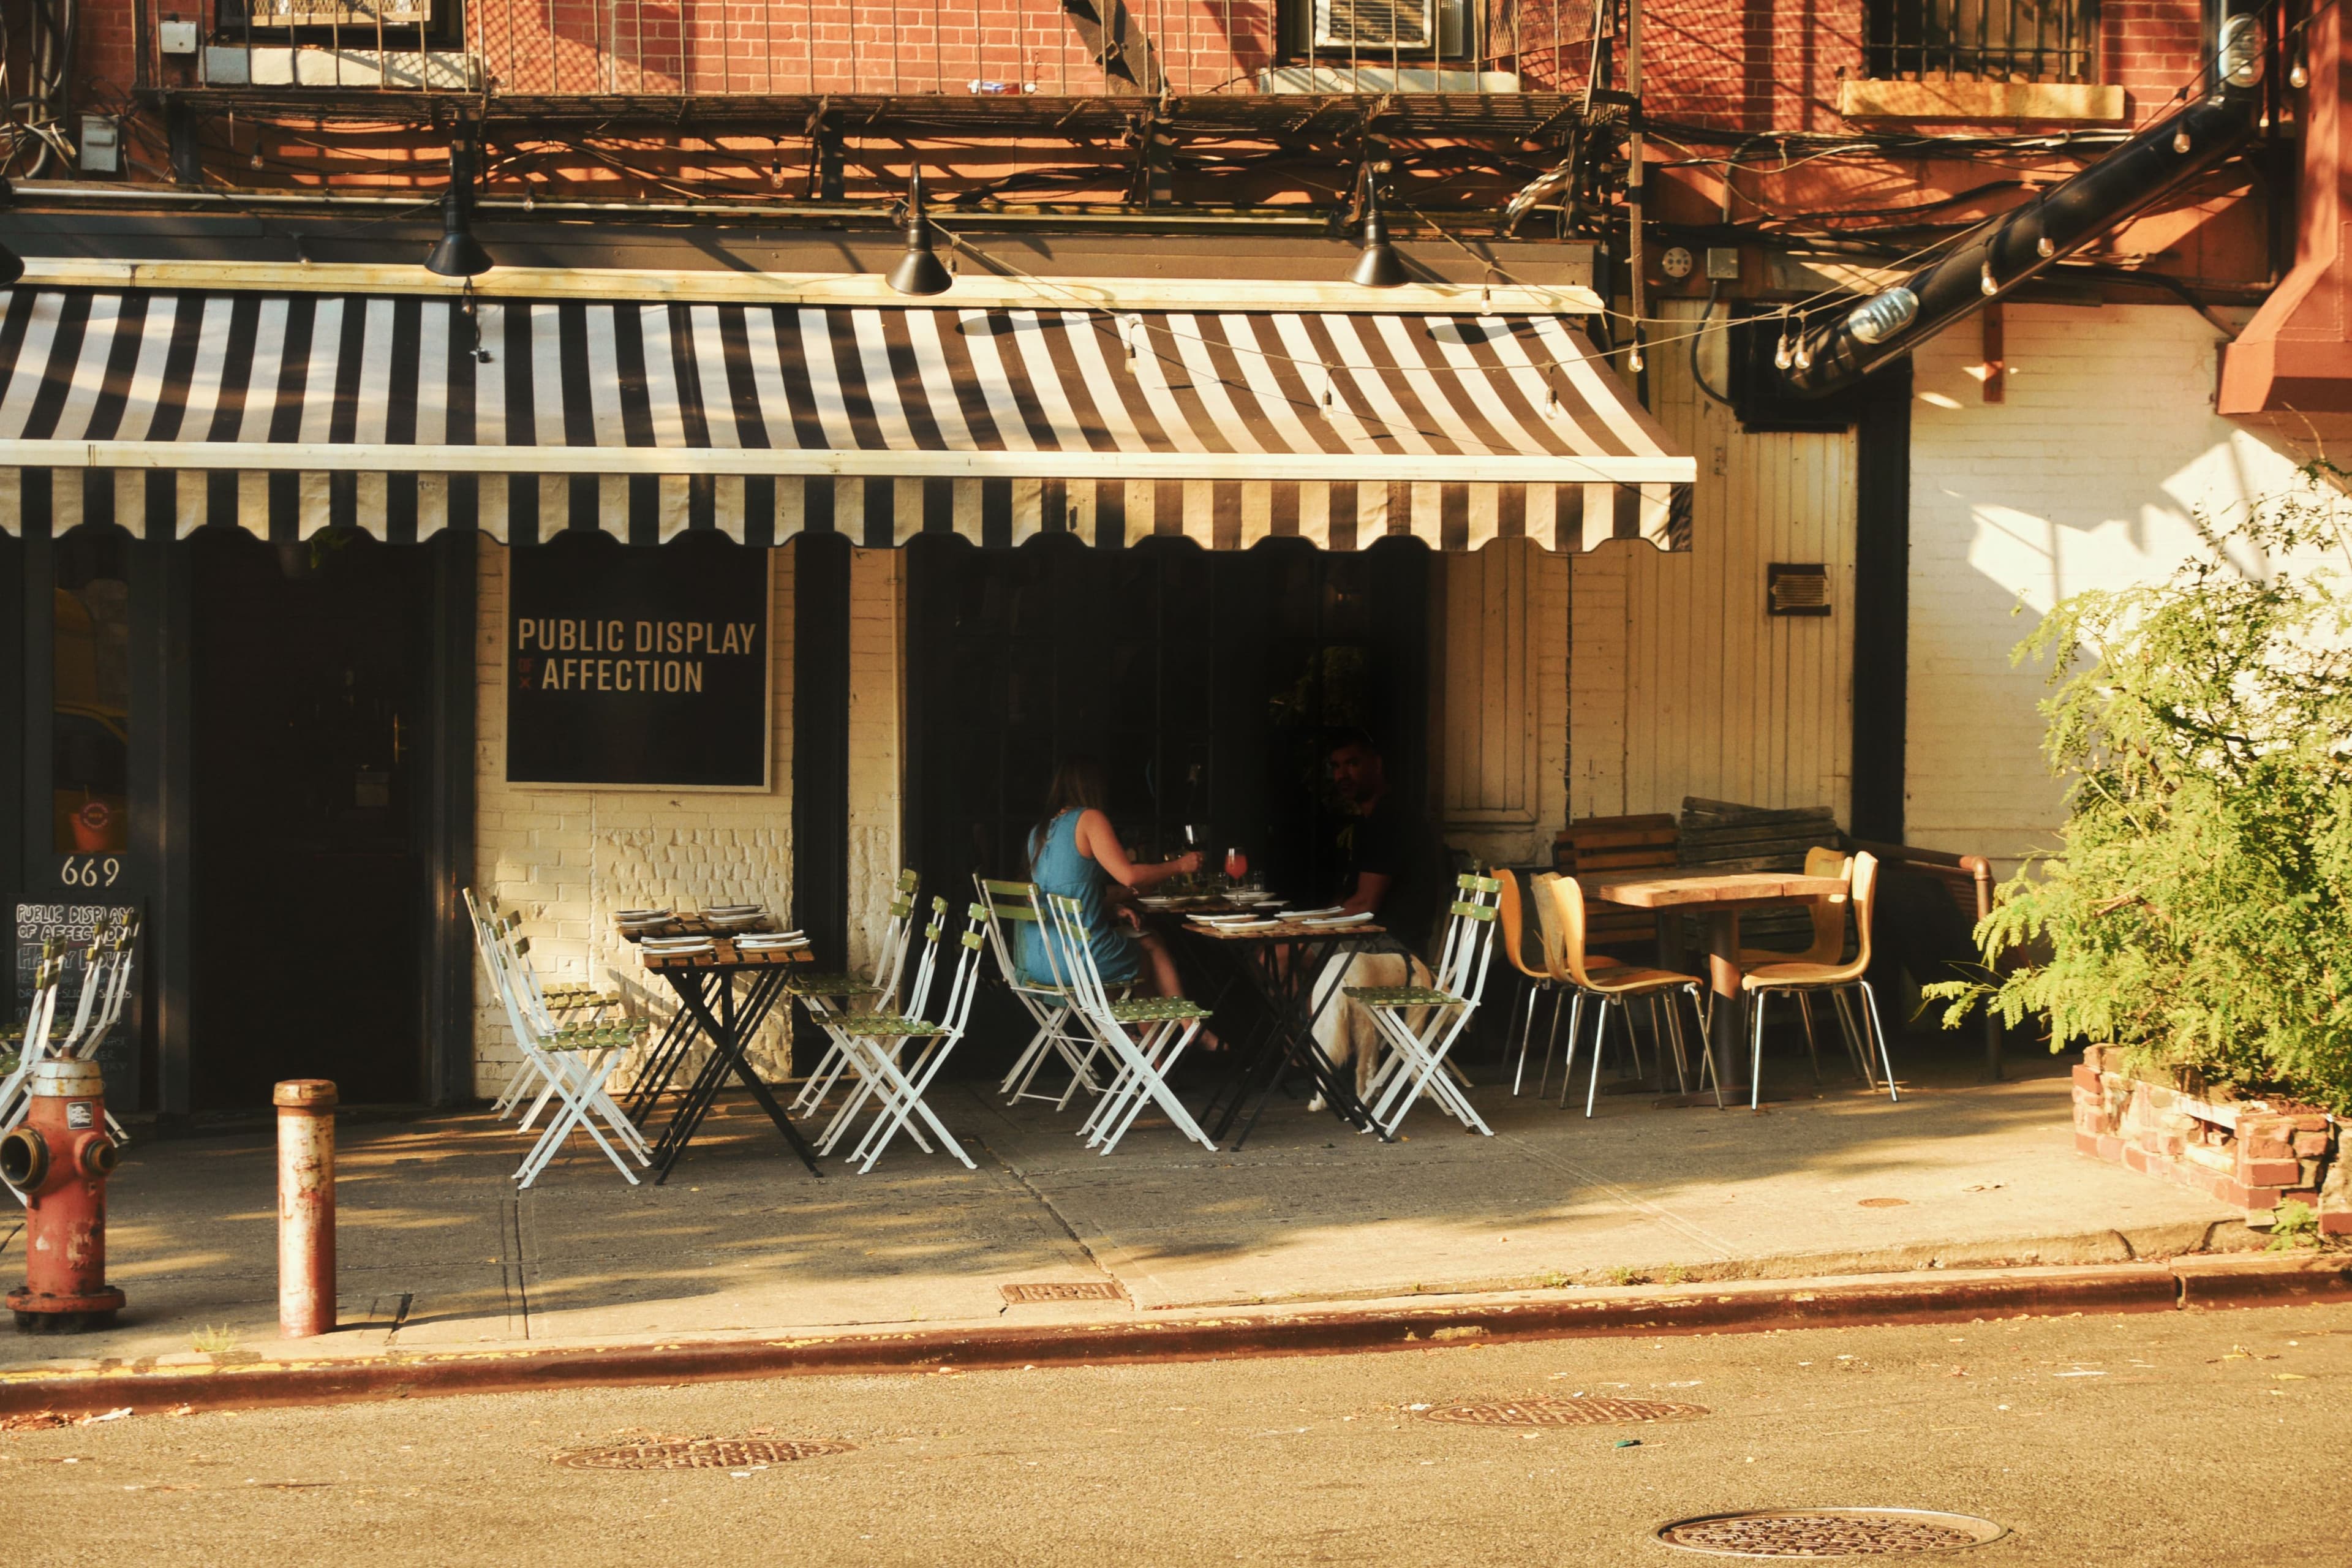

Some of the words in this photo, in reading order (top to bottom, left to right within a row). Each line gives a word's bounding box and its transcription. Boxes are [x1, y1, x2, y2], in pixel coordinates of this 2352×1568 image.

[518, 618, 624, 652] PUBLIC
[635, 620, 756, 655] DISPLAY
[541, 658, 703, 692] AFFECTION
[61, 856, 120, 887] 669
[17, 904, 64, 924] PUBLIC
[18, 924, 37, 938] OF
